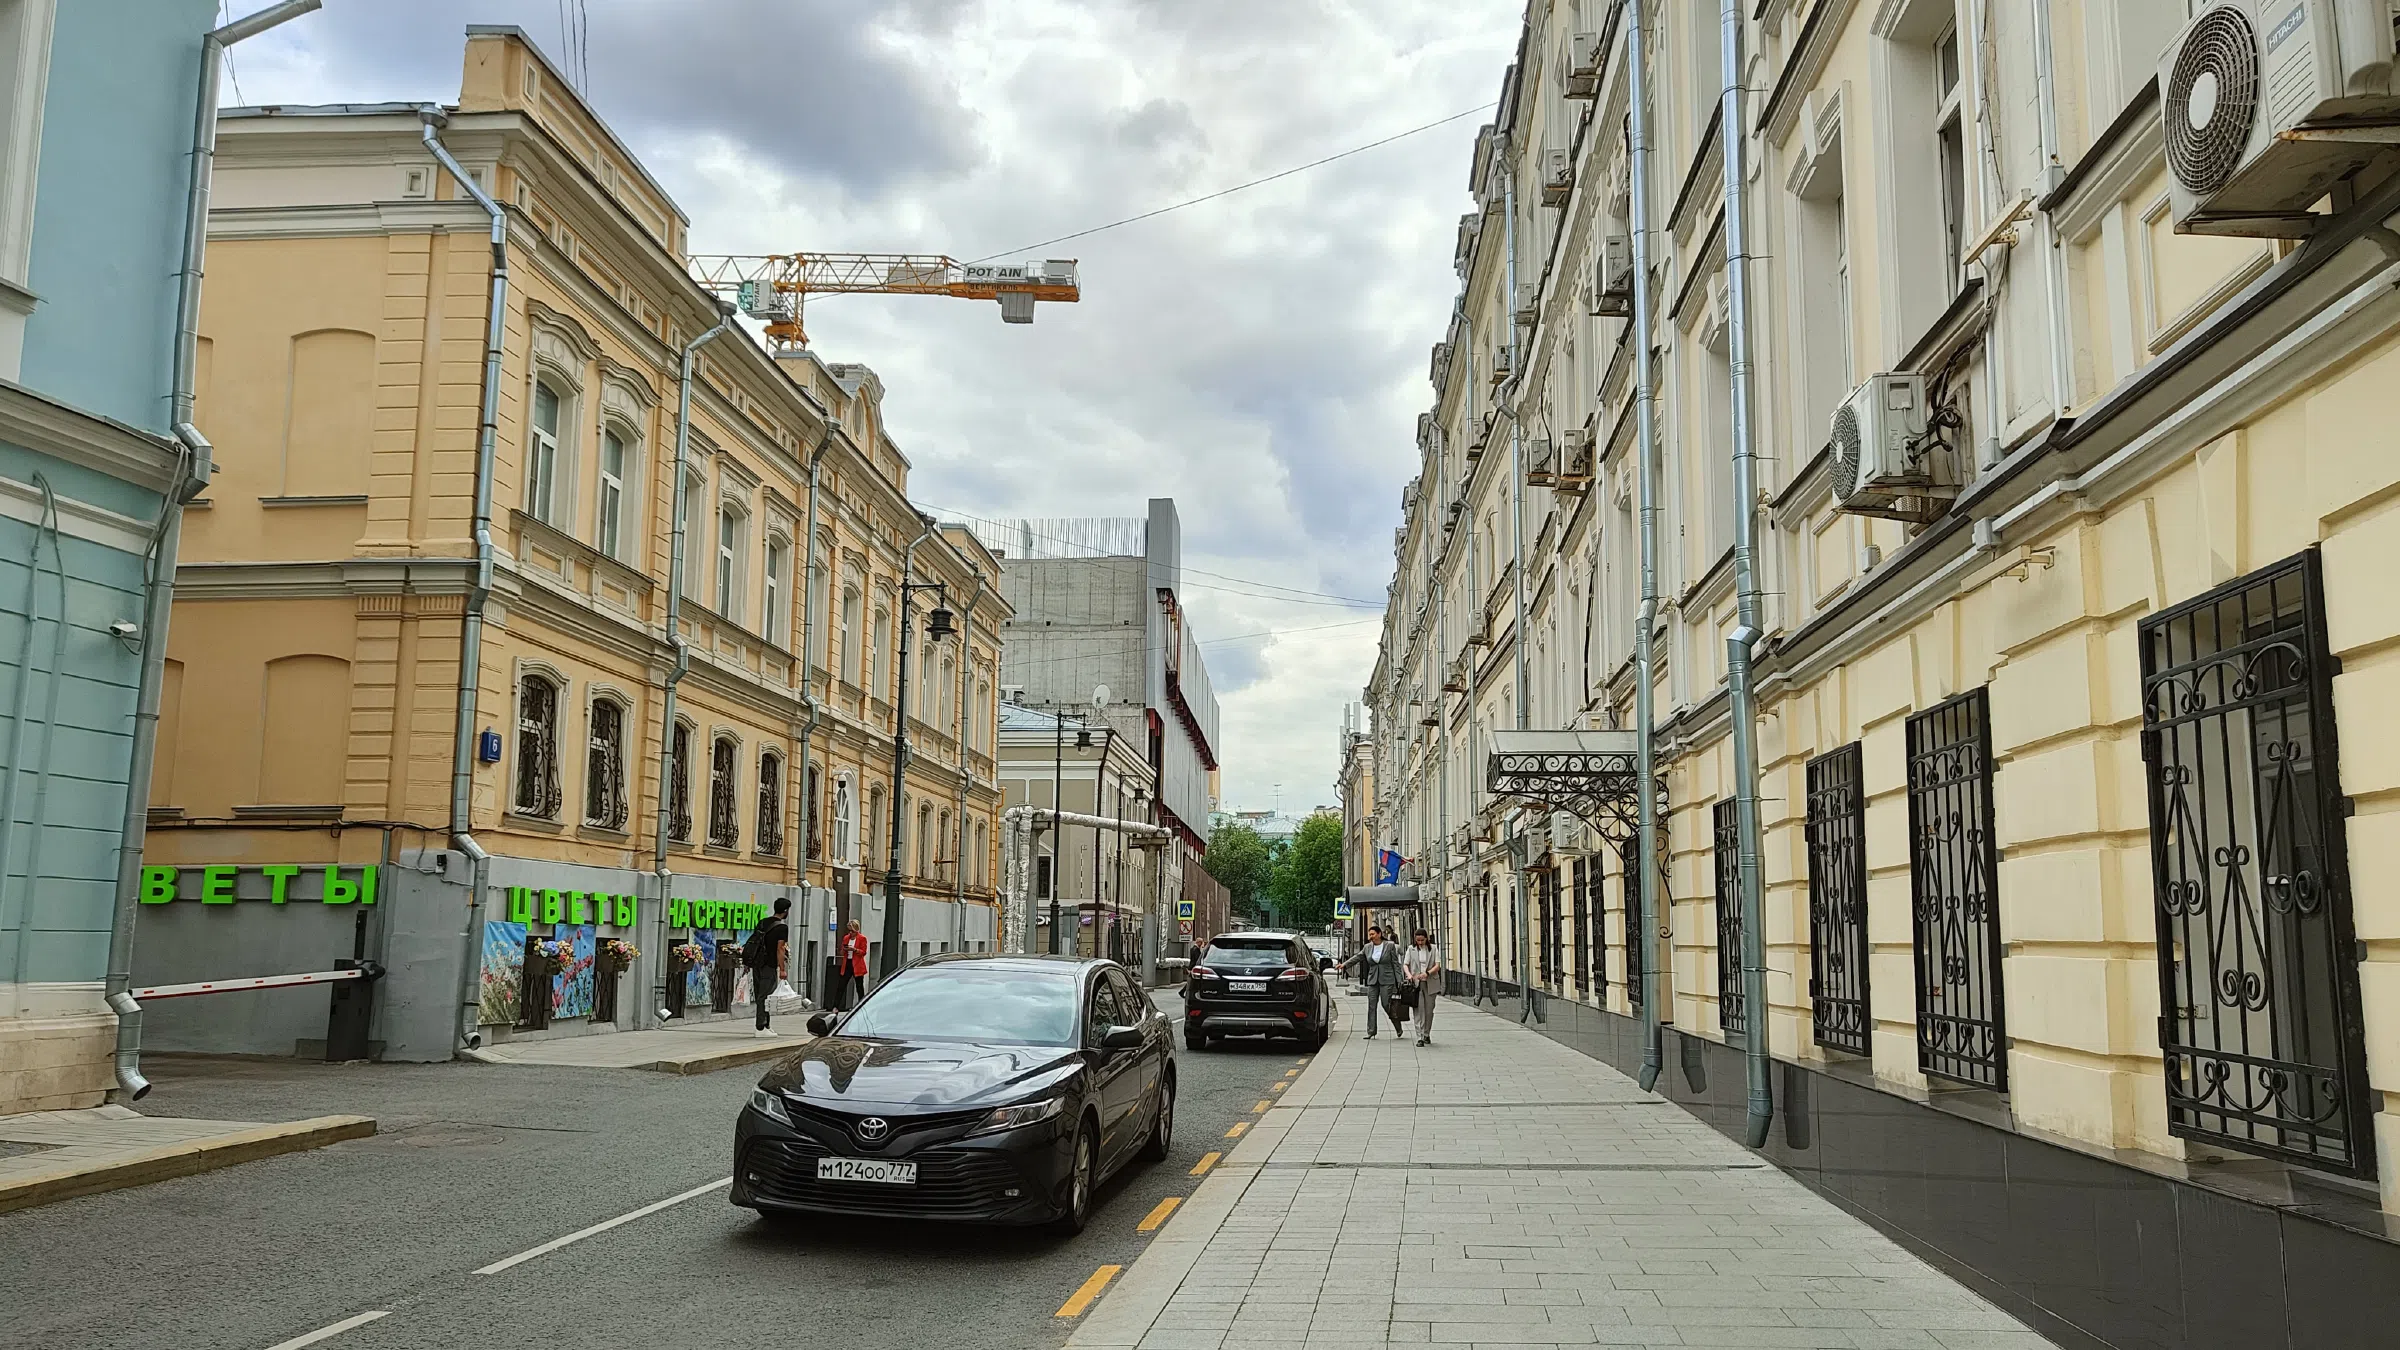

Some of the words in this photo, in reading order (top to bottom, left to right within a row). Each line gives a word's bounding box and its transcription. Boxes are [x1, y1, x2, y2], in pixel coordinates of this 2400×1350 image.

[2269, 9, 2302, 49] HITACHI
[967, 267, 993, 277] POT
[998, 267, 1022, 278] AIN
[493, 739, 498, 752] 6
[508, 886, 637, 931] ЦВЕТЫ
[669, 898, 690, 928] НА
[822, 1161, 885, 1180] М124ОО
[888, 1163, 913, 1176] 777
